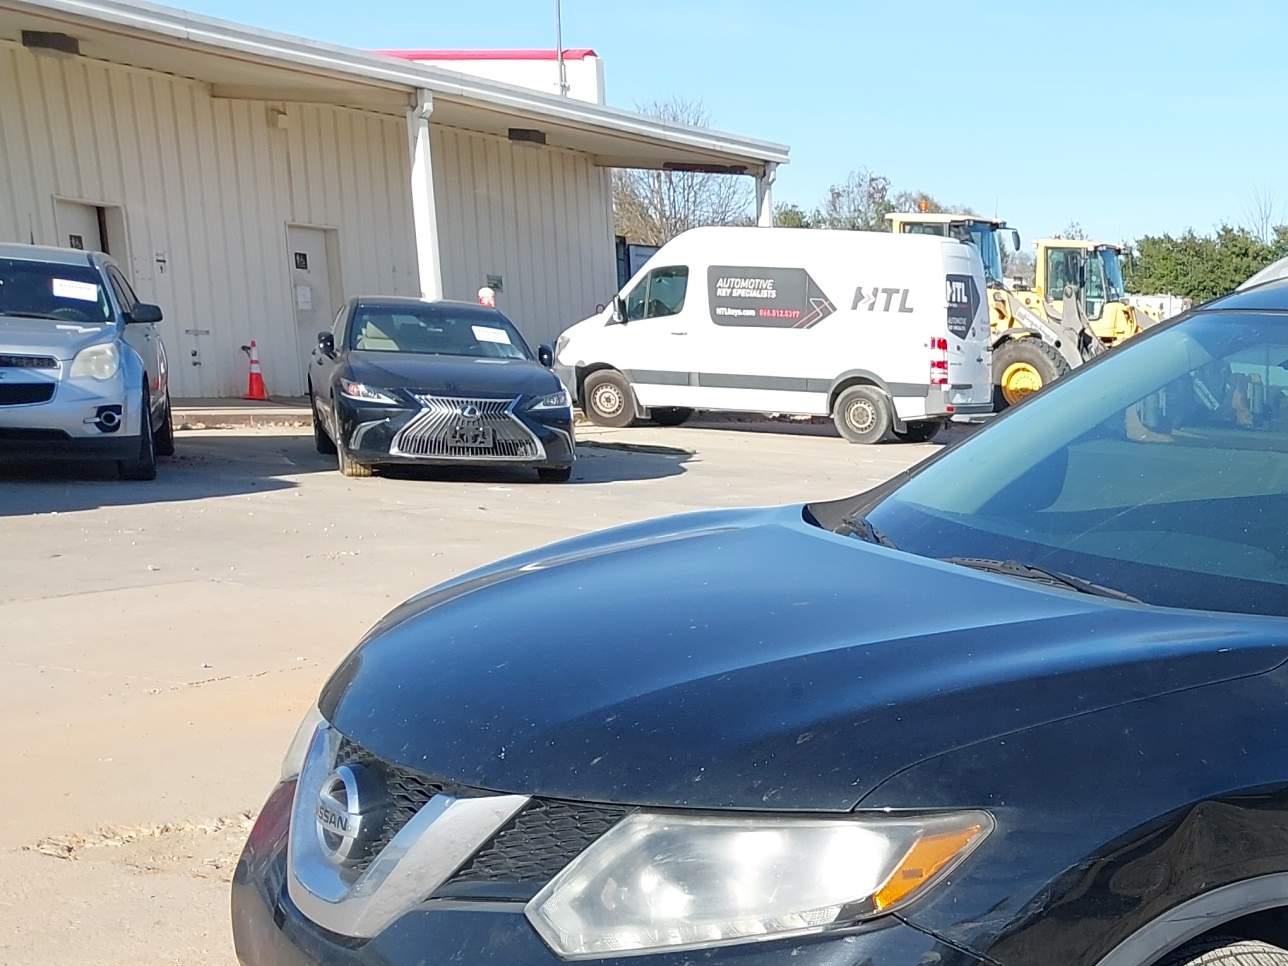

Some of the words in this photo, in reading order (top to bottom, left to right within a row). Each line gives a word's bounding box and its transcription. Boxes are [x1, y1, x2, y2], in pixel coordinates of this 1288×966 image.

[716, 277, 774, 290] AUTOMOTIVE
[716, 287, 731, 297] KEY
[731, 288, 777, 298] SPECIALISTS
[851, 286, 914, 313] HTL
[318, 806, 348, 832] SSAN
